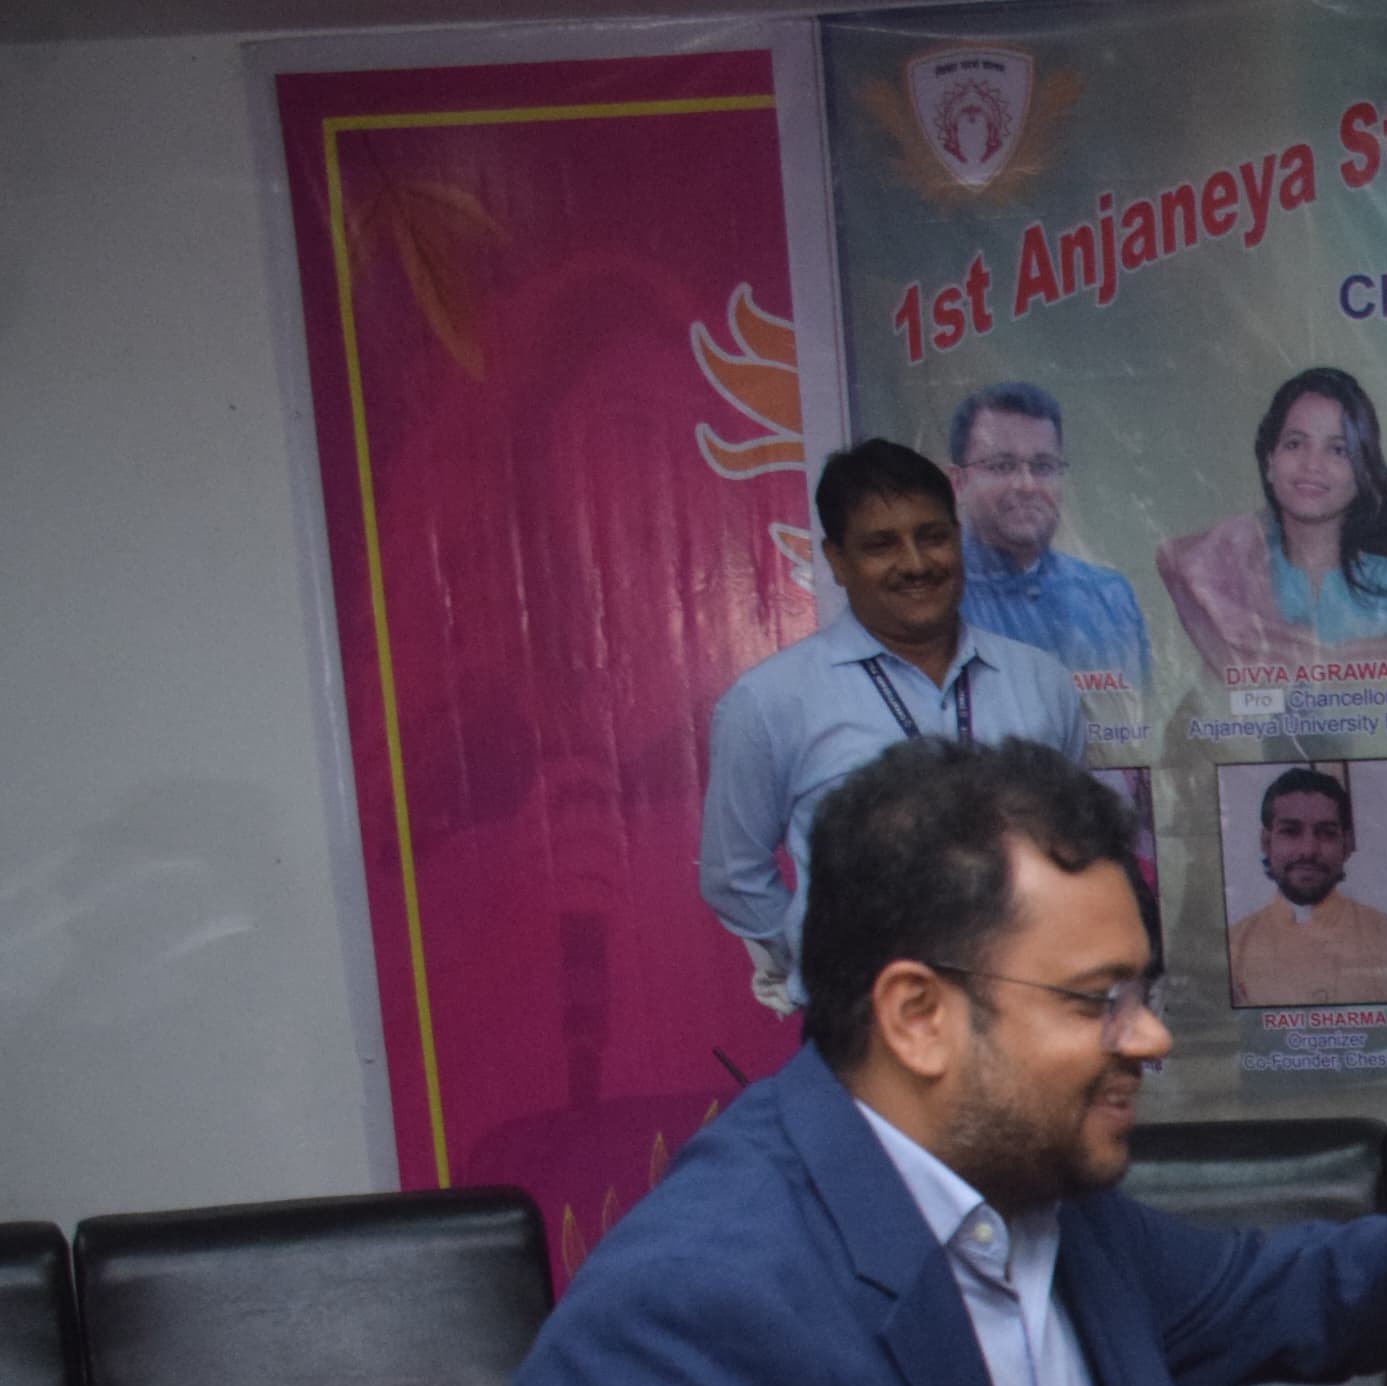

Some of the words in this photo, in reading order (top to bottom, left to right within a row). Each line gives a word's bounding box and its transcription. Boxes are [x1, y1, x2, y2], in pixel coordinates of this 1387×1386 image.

[893, 252, 992, 364] 1st
[1013, 144, 1317, 316] Anjaneya
[1227, 667, 1288, 686] DIVYA
[1244, 693, 1273, 708] Pro
[1088, 723, 1151, 744] Raipur
[1190, 719, 1278, 739] Anjaneya
[1285, 715, 1379, 736] University
[1264, 1013, 1305, 1028] RAVI
[1311, 1011, 1387, 1027] SHARMA
[1288, 1032, 1368, 1049] Organizer
